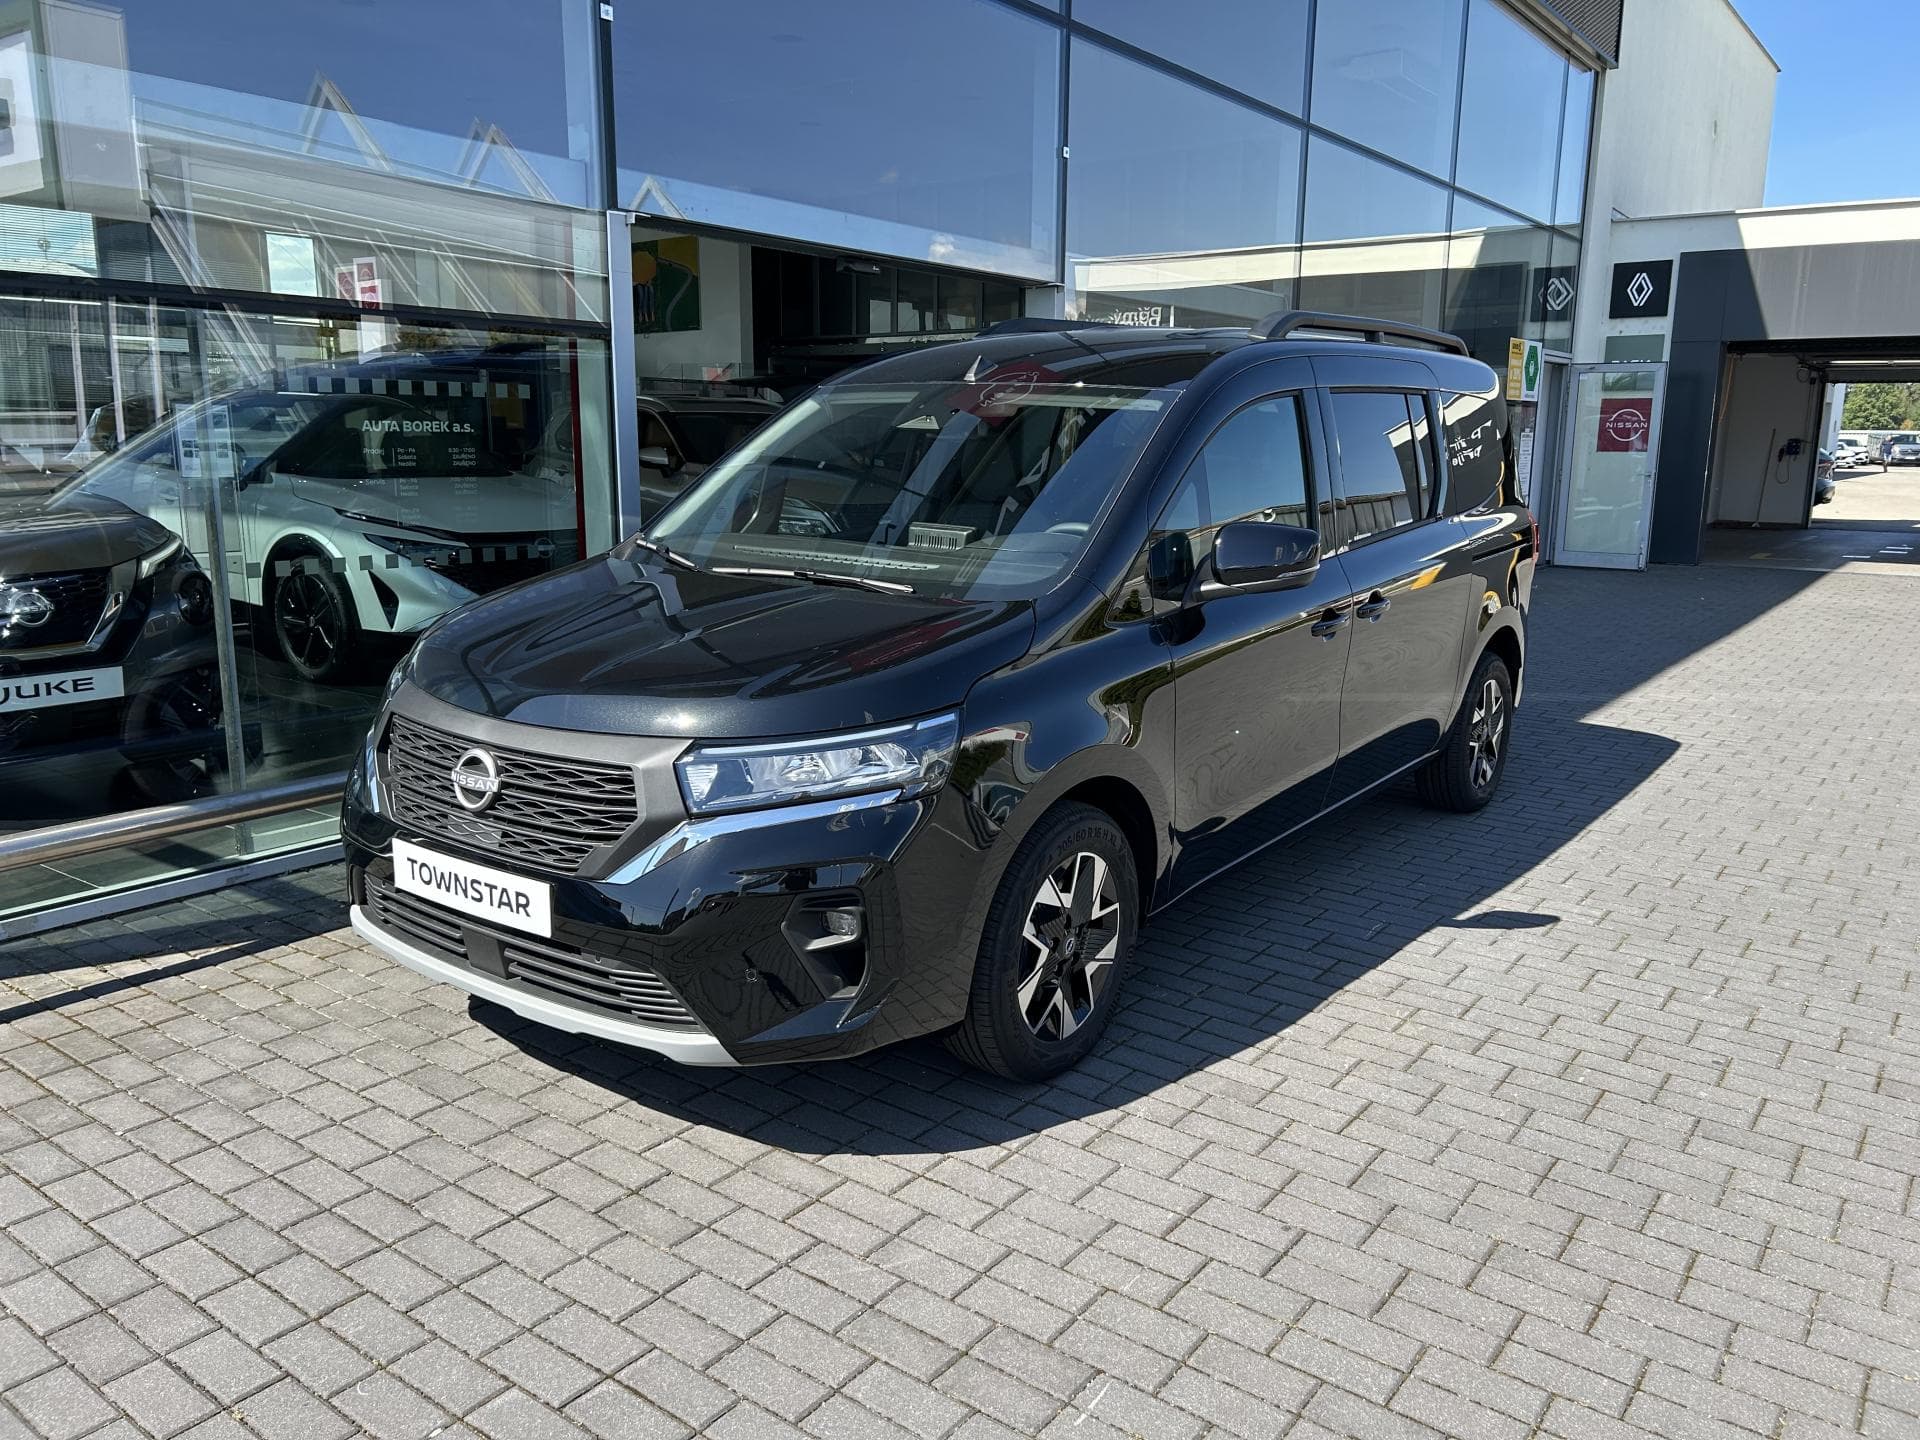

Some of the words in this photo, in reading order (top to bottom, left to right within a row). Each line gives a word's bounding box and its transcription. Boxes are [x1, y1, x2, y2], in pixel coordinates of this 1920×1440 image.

[362, 420, 400, 432] AUTA
[403, 420, 449, 432] BOREK
[452, 421, 474, 432] a.s.
[451, 770, 499, 792] NISSAN
[406, 857, 531, 917] TOWNSTAR
